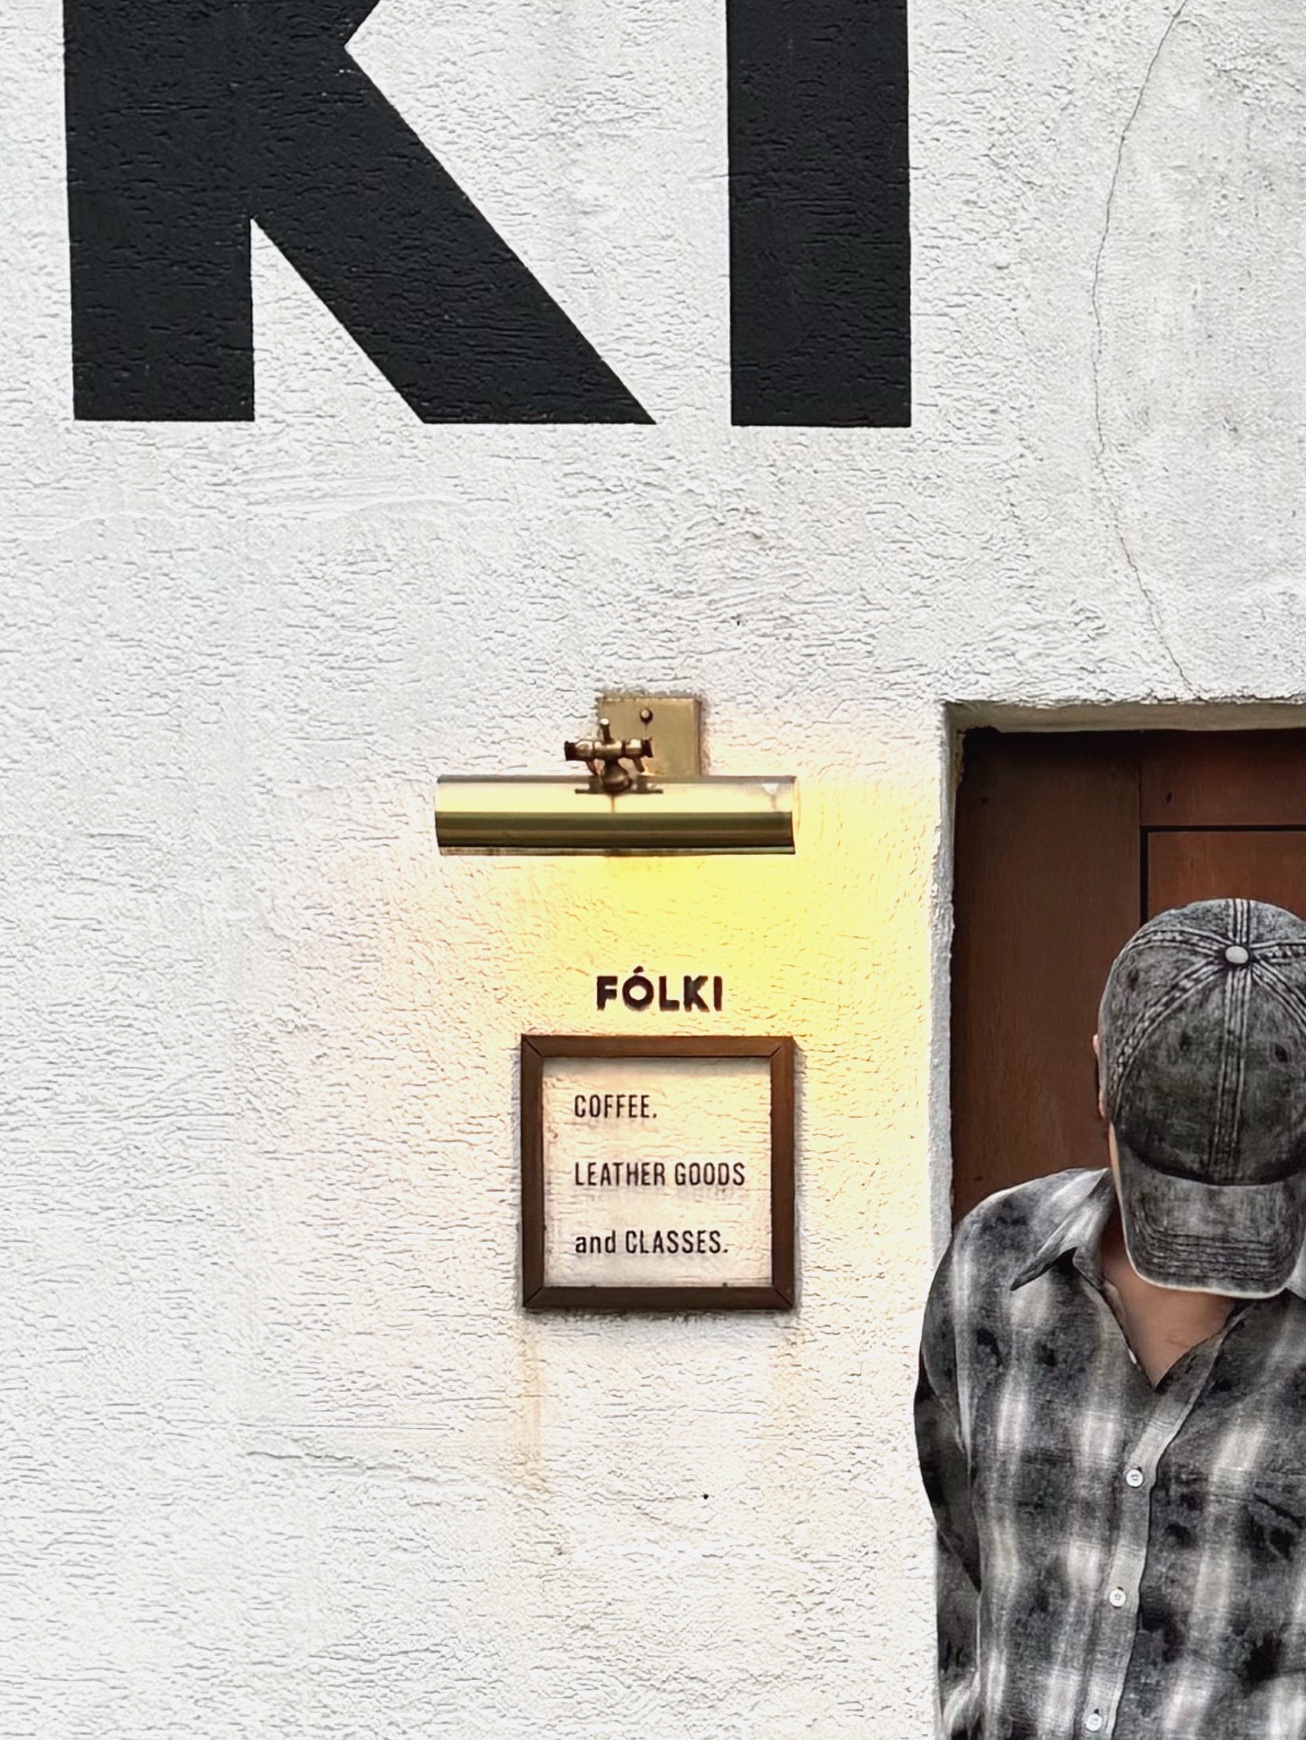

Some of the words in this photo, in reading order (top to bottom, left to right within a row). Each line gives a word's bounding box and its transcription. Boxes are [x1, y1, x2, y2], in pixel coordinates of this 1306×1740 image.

[63, 0, 912, 428] KI
[596, 965, 723, 1013] FÓLKI
[574, 1093, 658, 1119] COFFEE.
[574, 1161, 667, 1187] LEATHER
[674, 1161, 746, 1187] GOODS
[575, 1229, 617, 1254] and
[624, 1229, 729, 1254] CLASSES.
